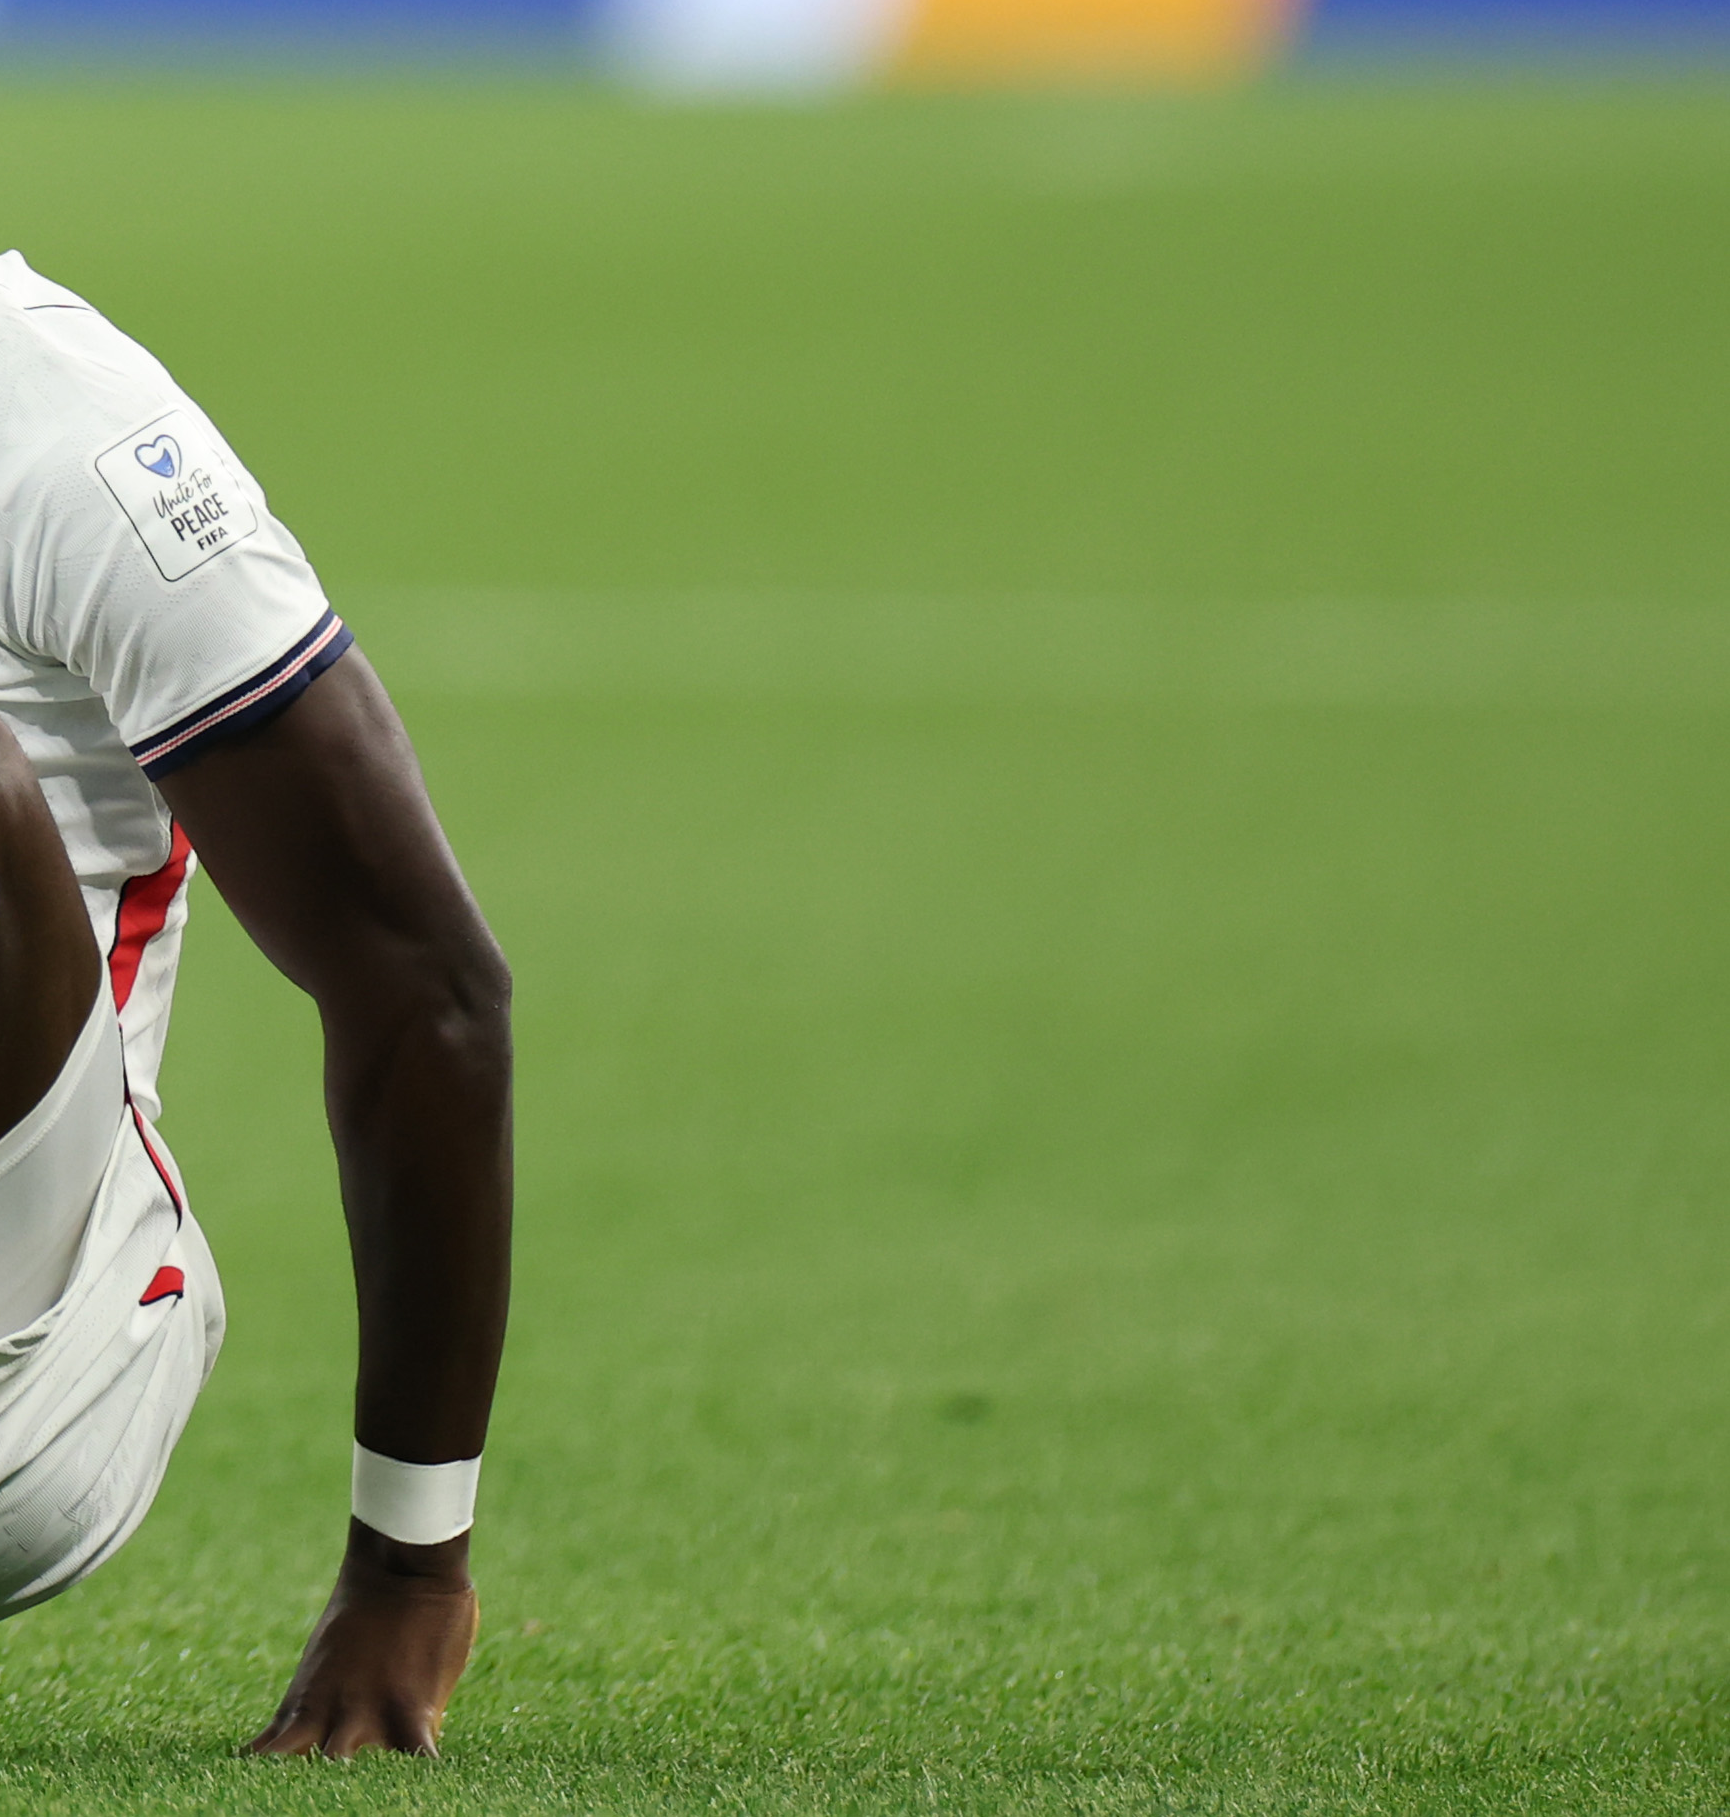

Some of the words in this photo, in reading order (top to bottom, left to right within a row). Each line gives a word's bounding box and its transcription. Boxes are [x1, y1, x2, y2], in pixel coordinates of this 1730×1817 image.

[152, 481, 195, 519] Unite
[189, 467, 213, 496] For
[170, 492, 230, 542] PEACE
[196, 526, 228, 551] FIFA
